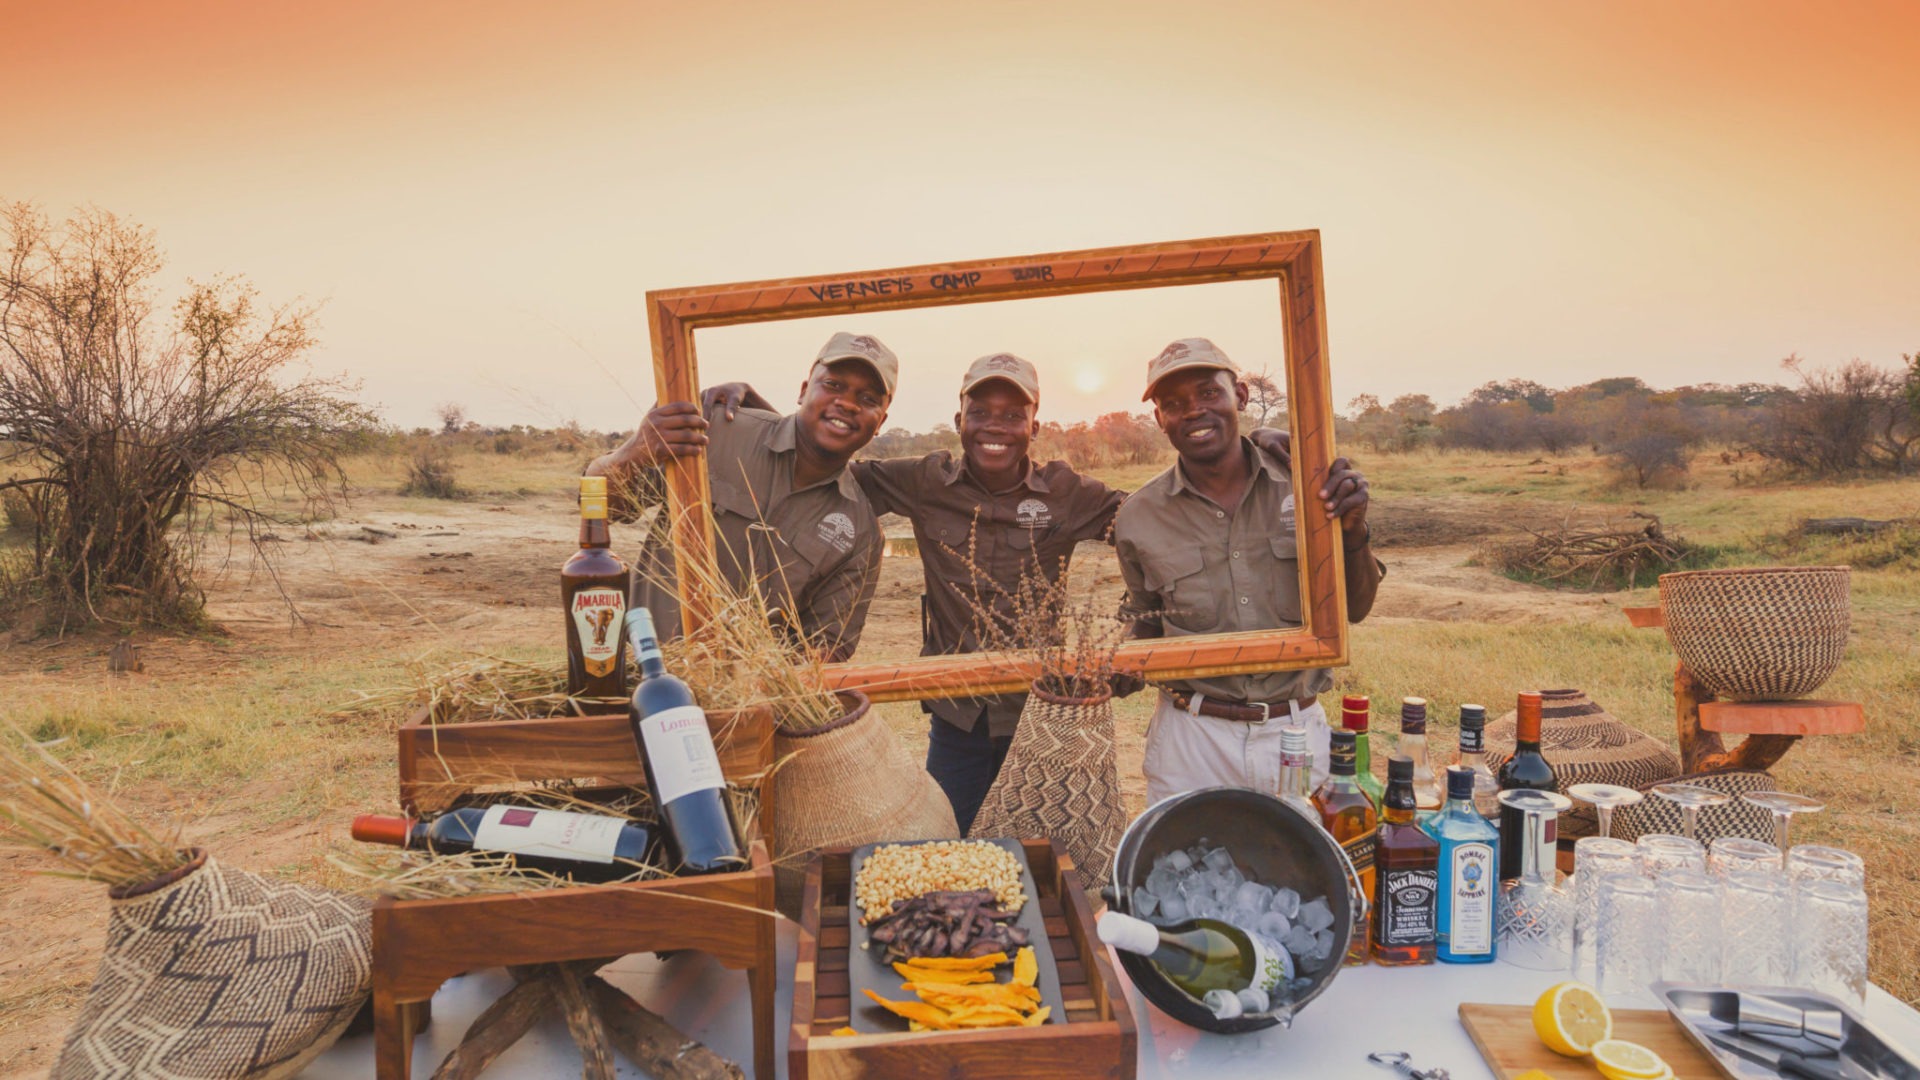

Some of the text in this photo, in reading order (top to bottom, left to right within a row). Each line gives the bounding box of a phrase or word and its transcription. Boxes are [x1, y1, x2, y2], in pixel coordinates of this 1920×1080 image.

[808, 277, 914, 301] VERNEYS
[930, 271, 982, 290] CAMP
[575, 591, 623, 611] AMARULA
[1459, 850, 1486, 862] BOMBAY
[1388, 877, 1408, 894] JACK
[1457, 888, 1486, 899] SAPPHIRE
